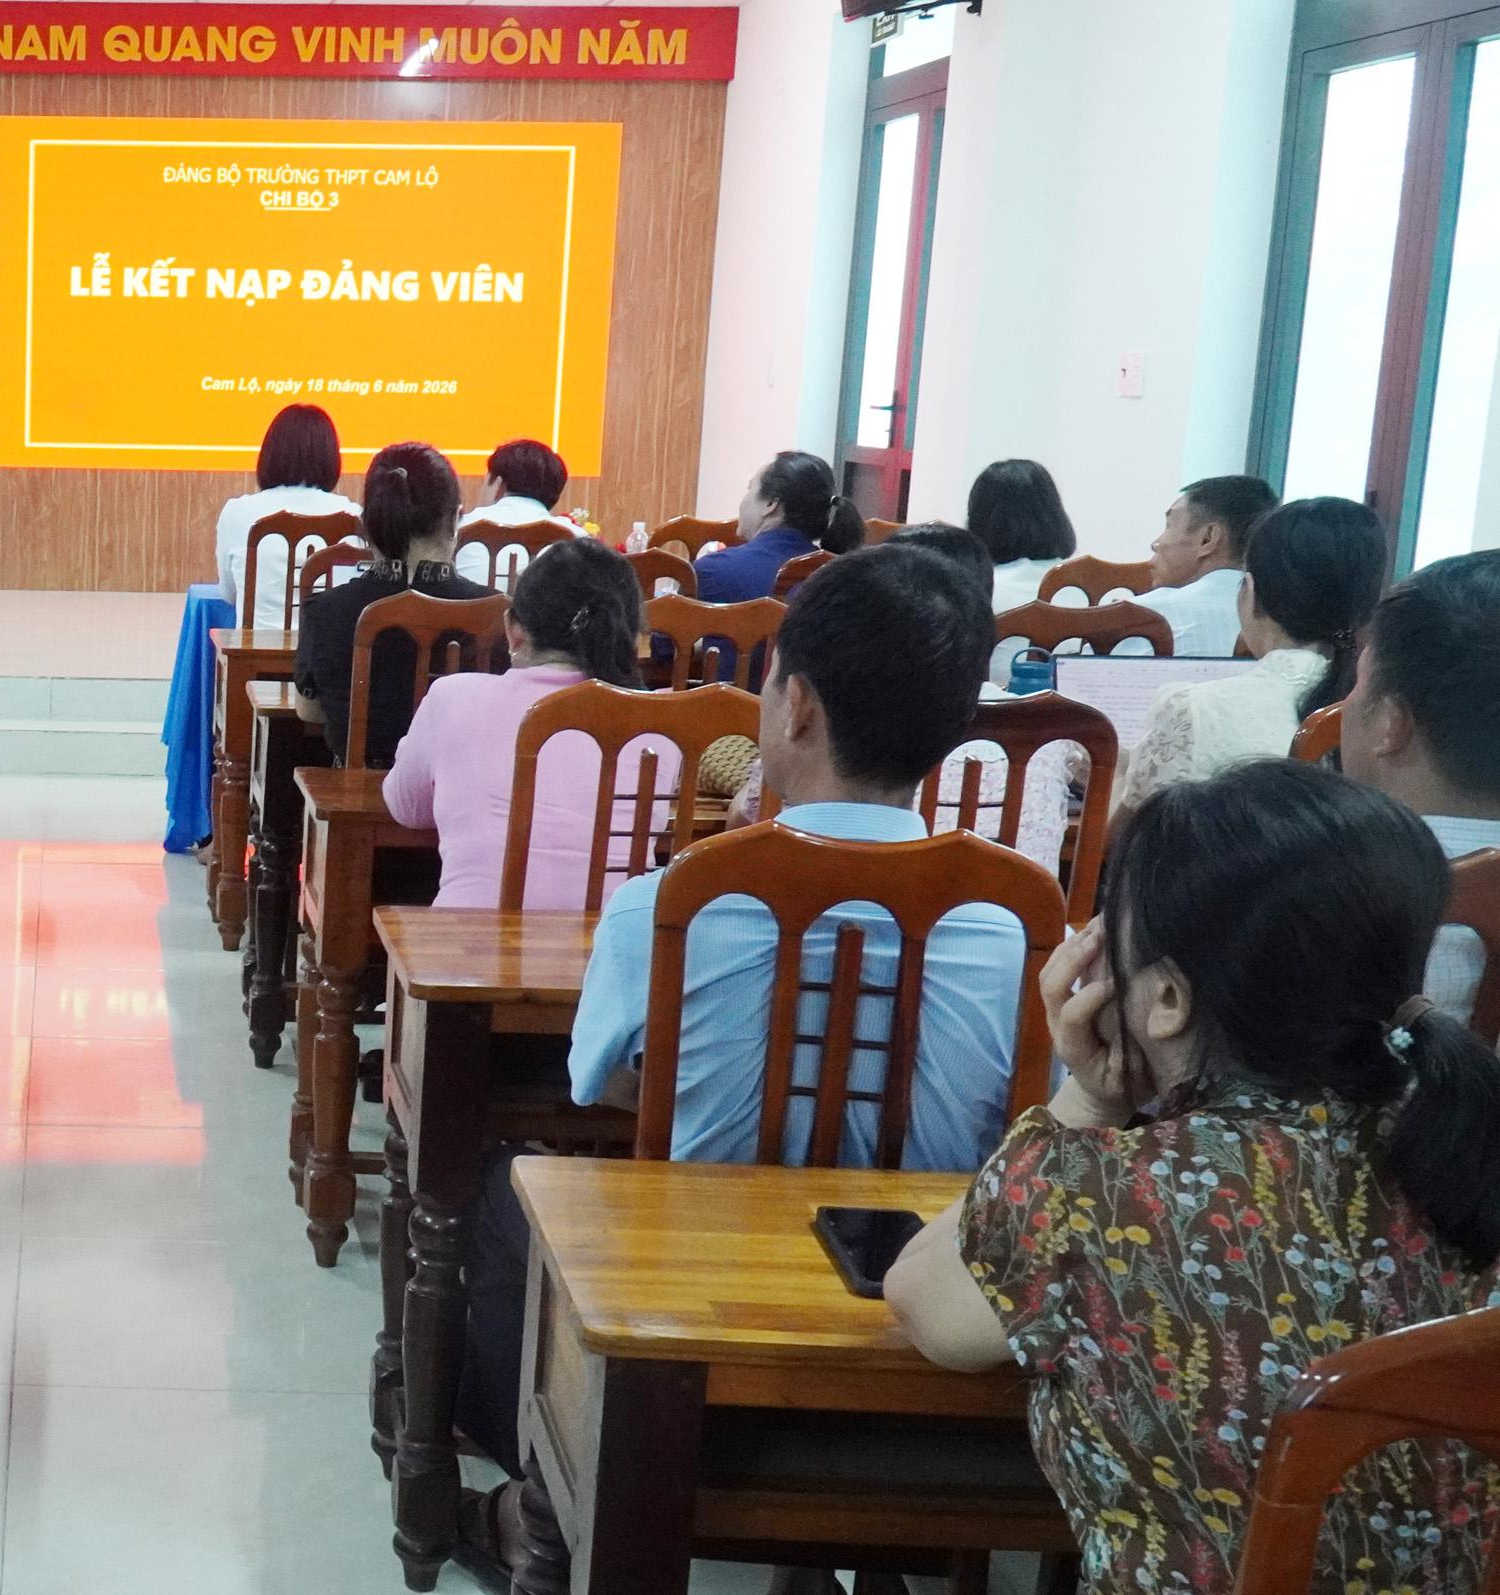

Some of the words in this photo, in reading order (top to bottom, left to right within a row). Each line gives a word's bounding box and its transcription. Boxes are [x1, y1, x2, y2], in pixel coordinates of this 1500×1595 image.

[102, 25, 277, 63] QUANG
[291, 26, 405, 64] VINH
[418, 18, 563, 65] MUÔN
[577, 20, 688, 66] NĂM
[216, 164, 242, 187] BỘ
[245, 163, 320, 185] TRƯỜNG
[323, 168, 370, 186] THPT
[373, 169, 412, 186] CAM
[415, 165, 440, 189] LỘ
[259, 190, 293, 206] CHI
[329, 192, 340, 207] 3
[69, 252, 112, 297] LỄ
[122, 256, 196, 298] KẾT
[205, 268, 292, 307] NẠP
[300, 259, 421, 301] ĐẢNG
[430, 263, 525, 303] VIÊN
[201, 376, 235, 391] Cam
[264, 379, 303, 395] ngày
[327, 379, 370, 396] tháng
[373, 380, 384, 393] 6
[385, 380, 419, 394] năm
[421, 380, 459, 394] 2026
